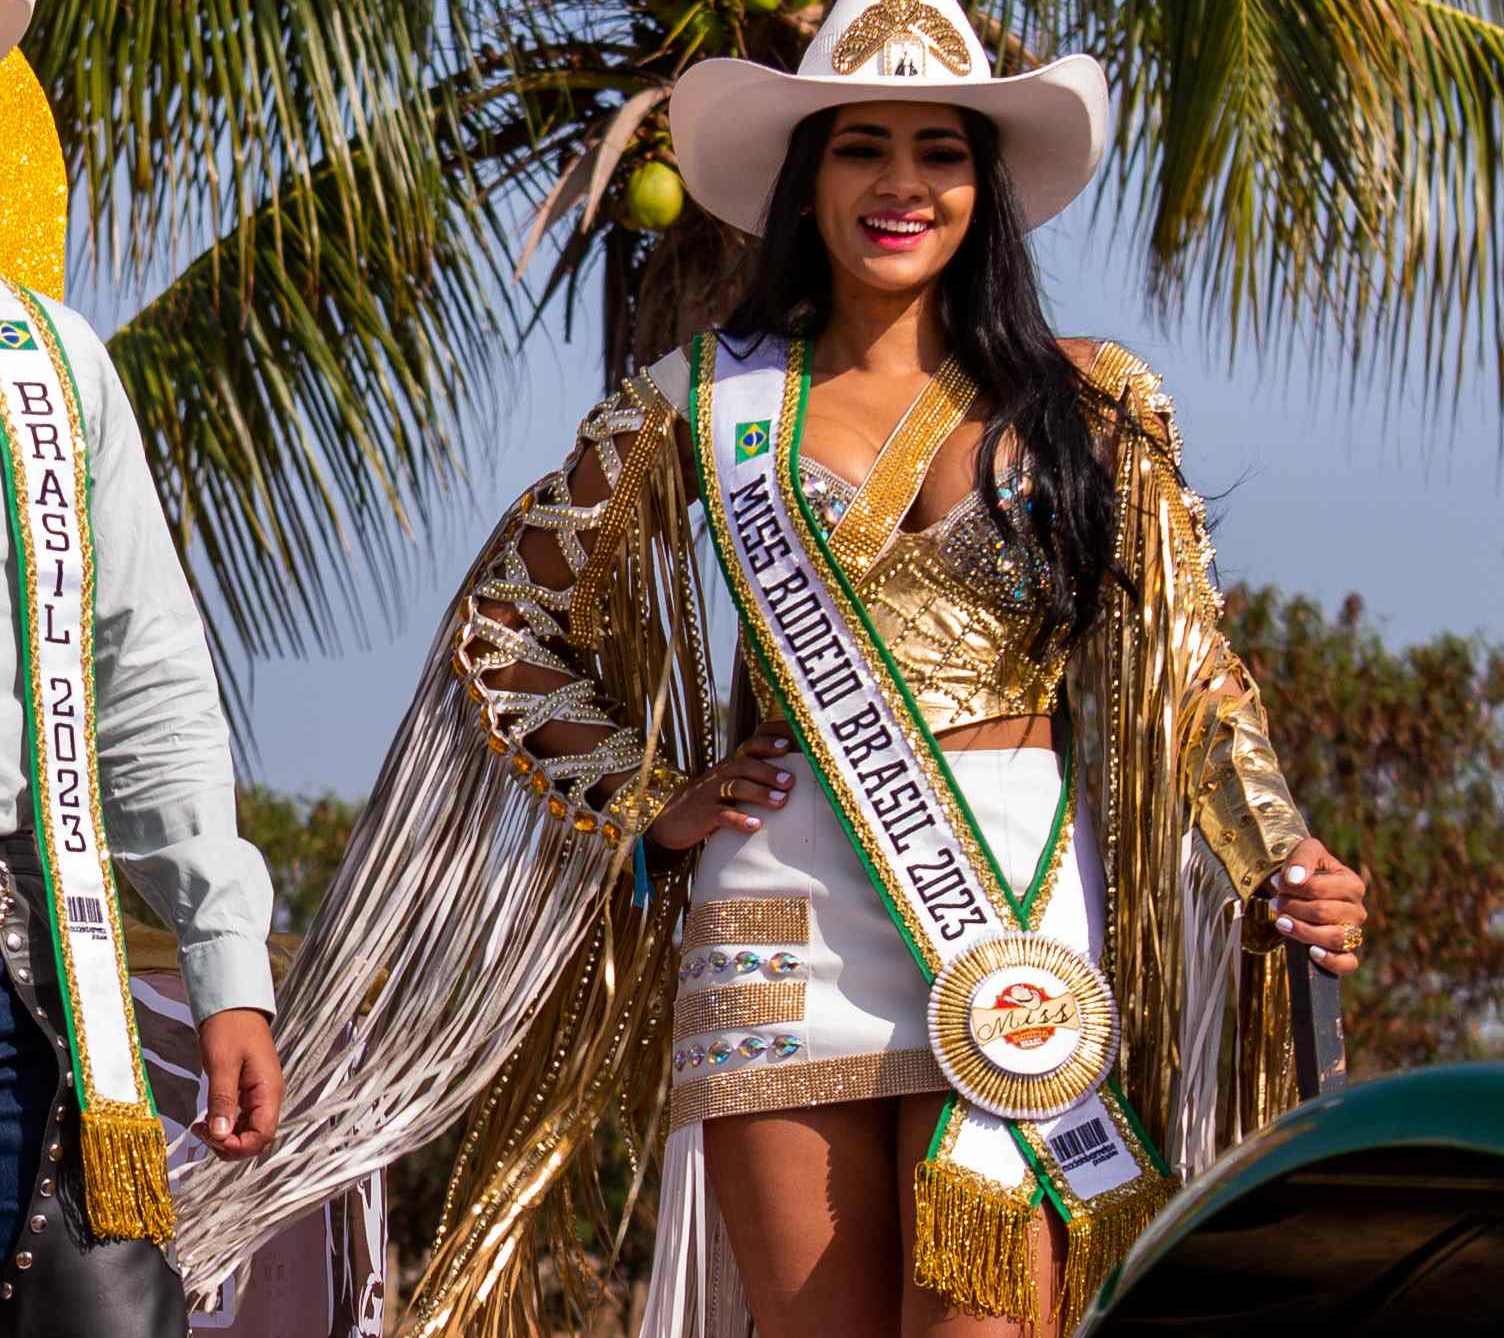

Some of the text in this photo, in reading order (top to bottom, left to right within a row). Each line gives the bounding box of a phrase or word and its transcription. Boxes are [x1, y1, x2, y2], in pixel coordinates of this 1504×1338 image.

[13, 381, 87, 852] BRASIL 2023
[729, 473, 986, 942] MISS RODEIO BRASIL 2023
[976, 1003, 1074, 1040] Miss
